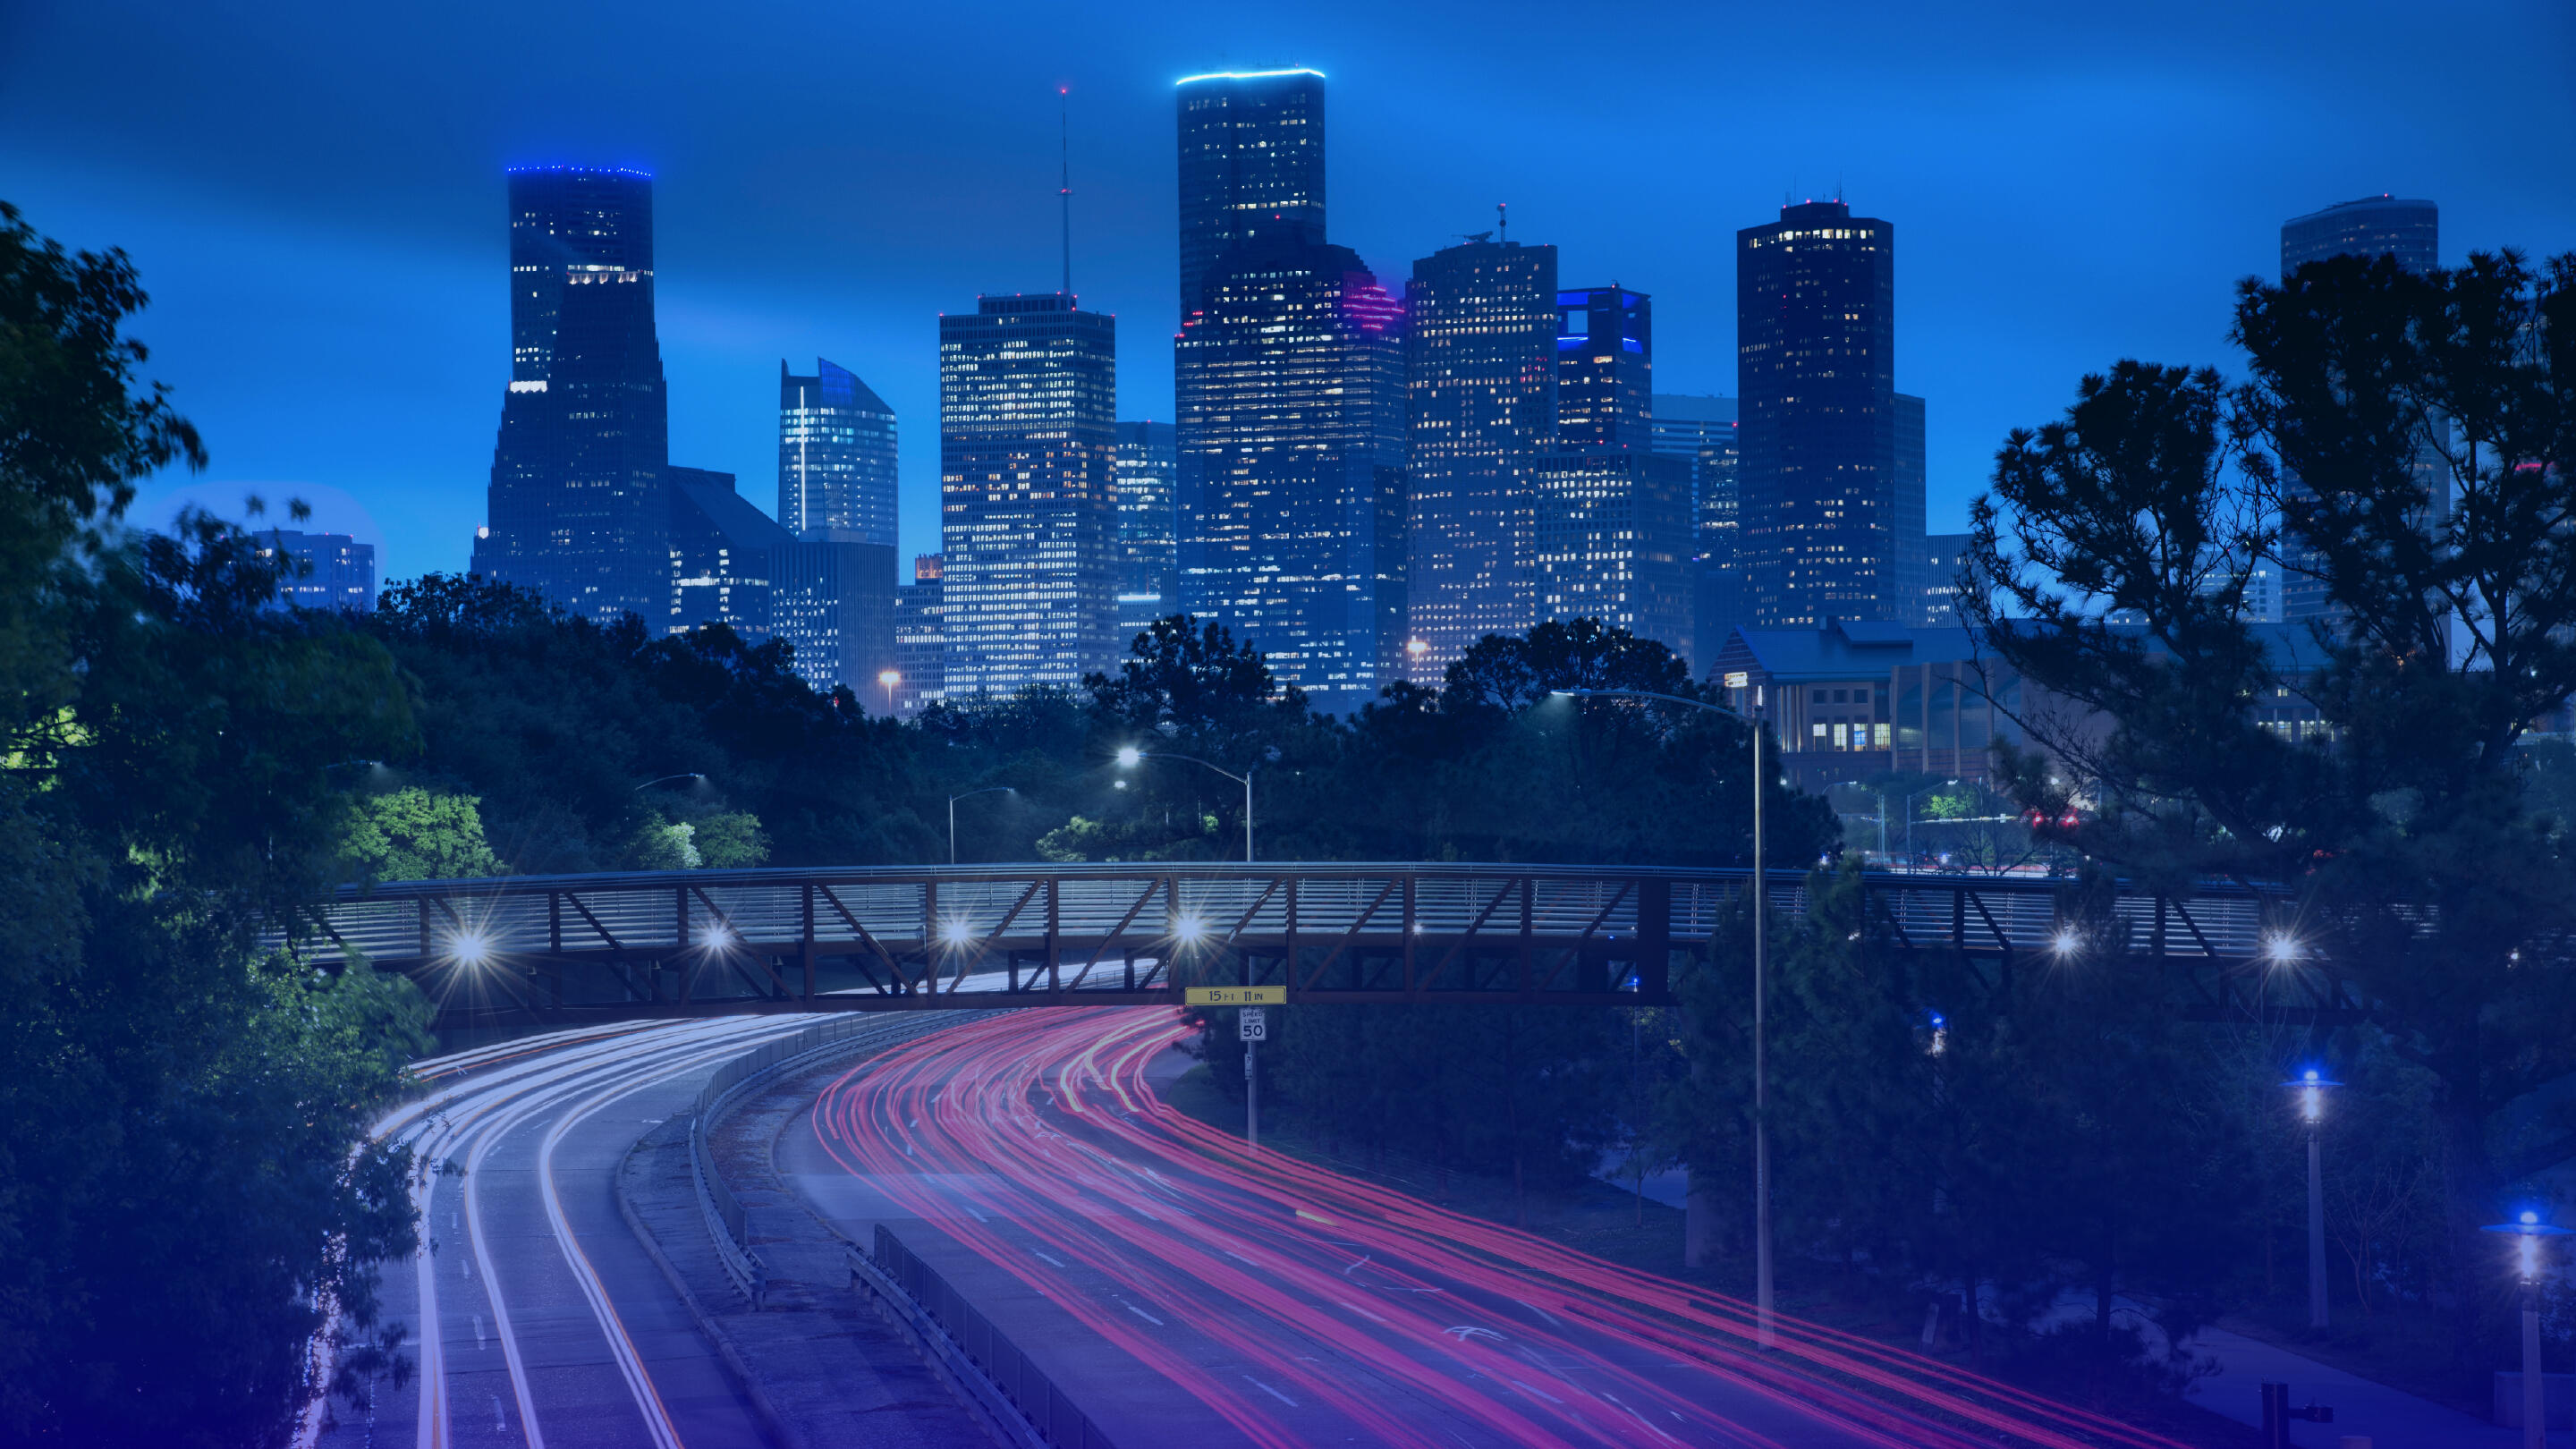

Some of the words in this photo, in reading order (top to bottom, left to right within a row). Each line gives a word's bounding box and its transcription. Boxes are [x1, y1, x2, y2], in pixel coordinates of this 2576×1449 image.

[1208, 990, 1222, 1002] 15
[1224, 993, 1234, 1001] FT
[1243, 990, 1251, 1002] 11
[1254, 993, 1263, 1001] IN
[1243, 1025, 1263, 1037] 50
